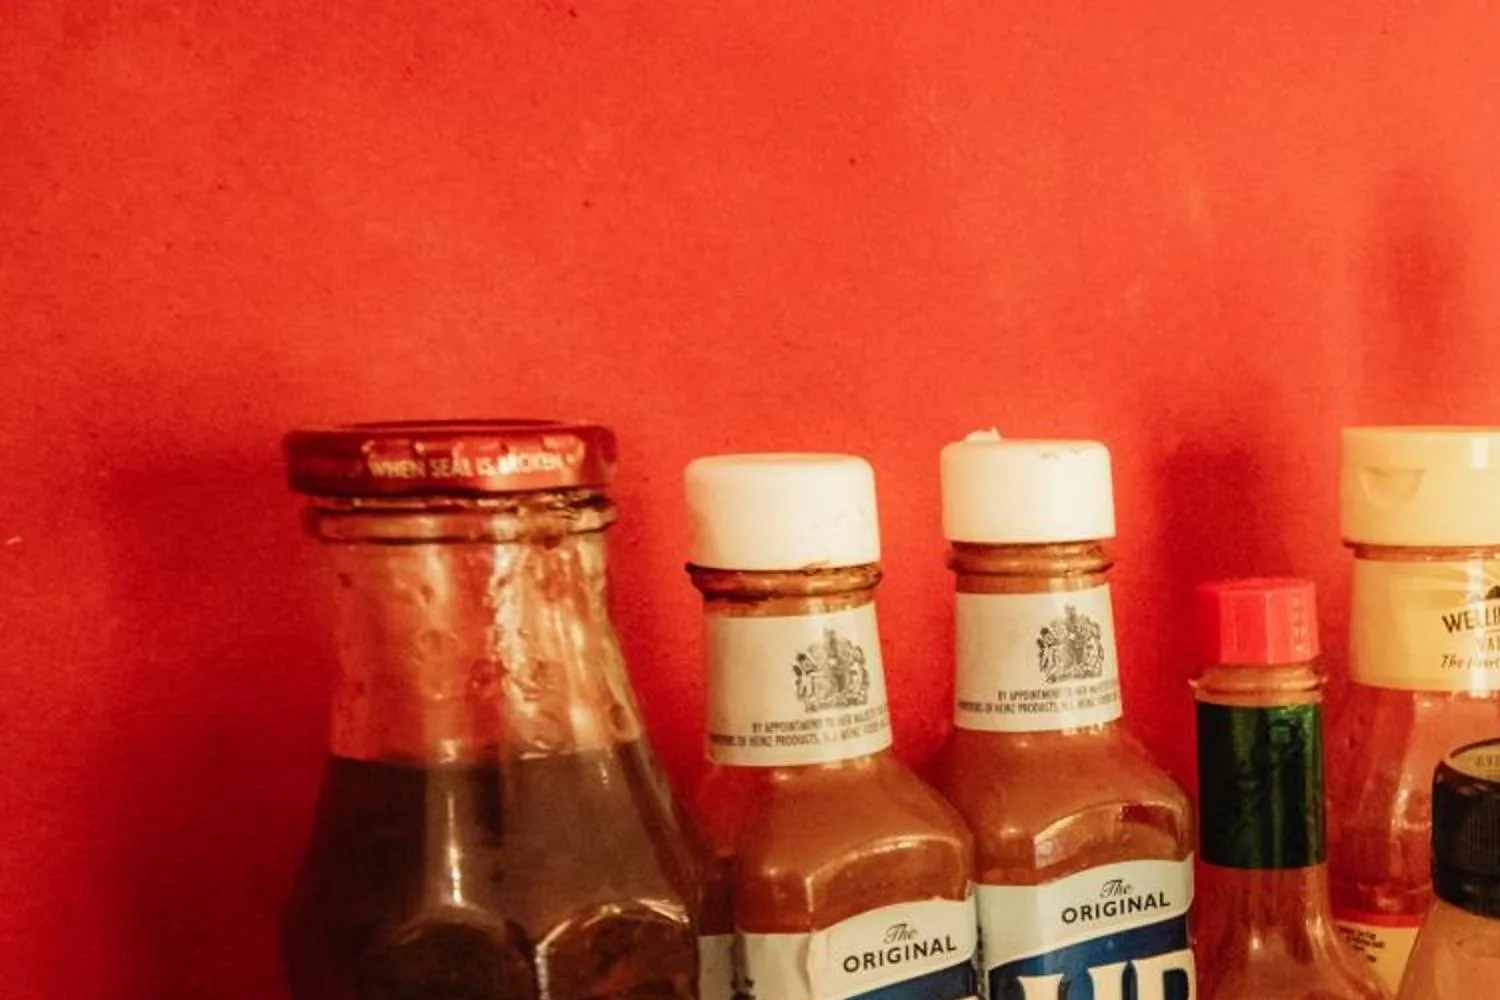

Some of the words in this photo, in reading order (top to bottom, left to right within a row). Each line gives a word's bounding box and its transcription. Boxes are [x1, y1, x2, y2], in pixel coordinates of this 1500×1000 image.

[1100, 879, 1133, 898] The
[1061, 889, 1171, 924] ORIGINAL
[883, 922, 919, 944] The
[843, 934, 957, 973] ORIGINAL
